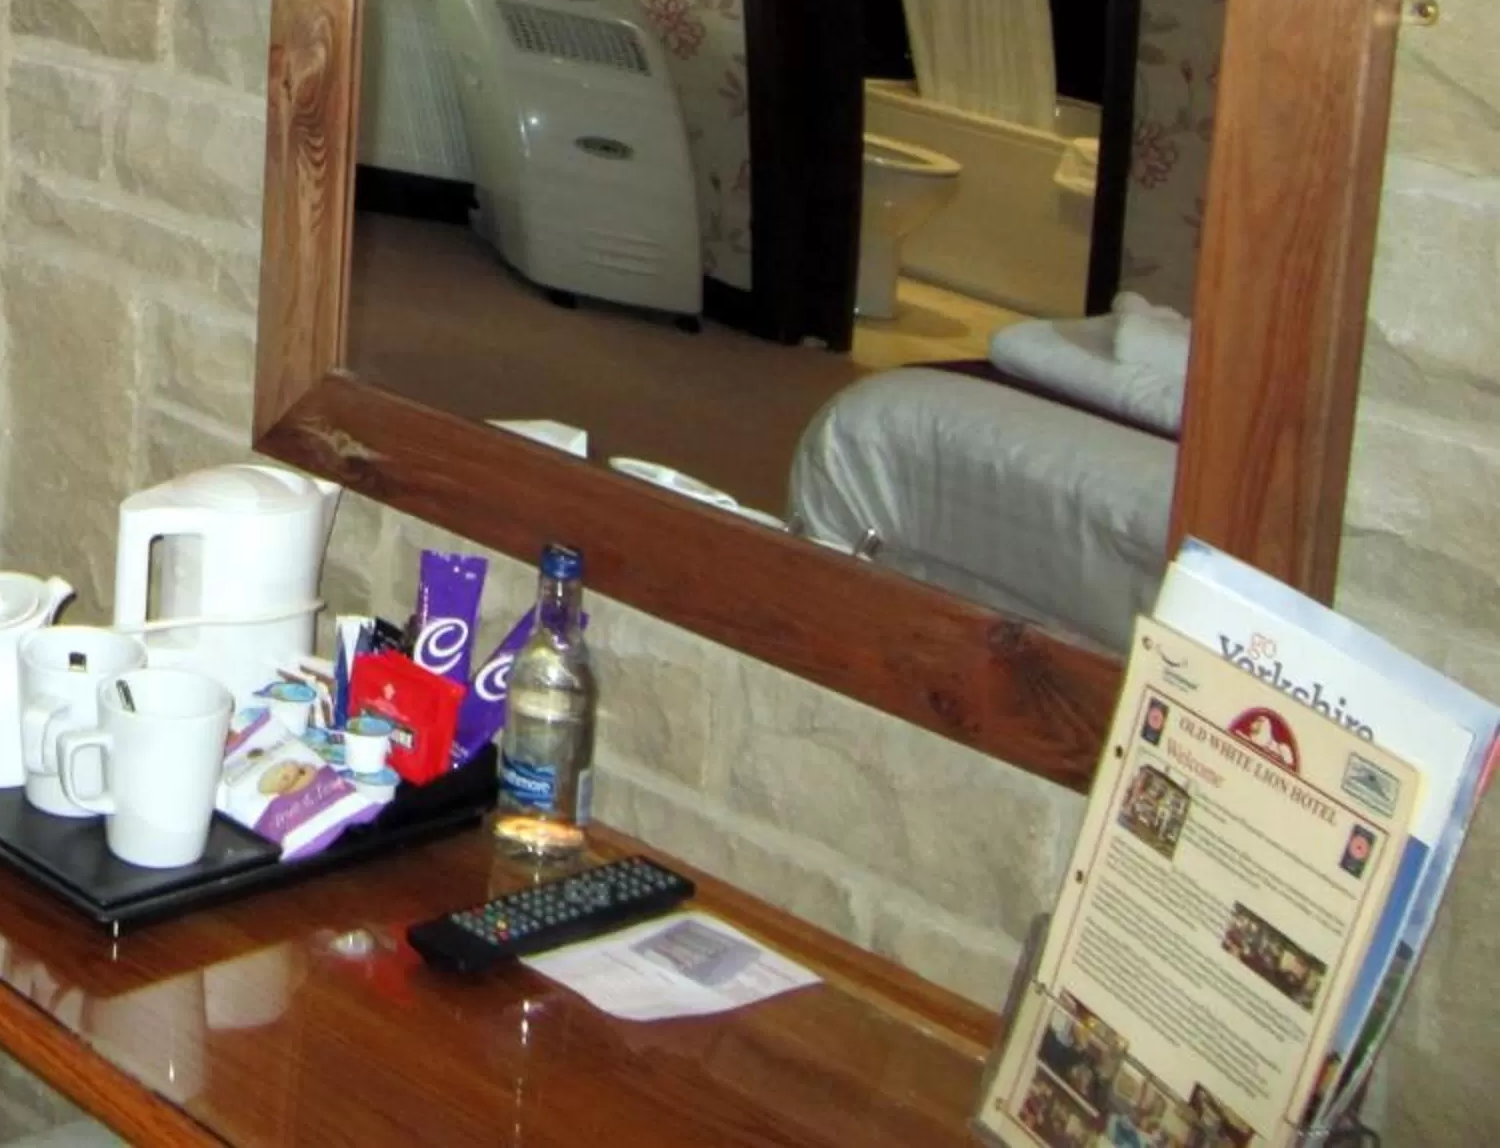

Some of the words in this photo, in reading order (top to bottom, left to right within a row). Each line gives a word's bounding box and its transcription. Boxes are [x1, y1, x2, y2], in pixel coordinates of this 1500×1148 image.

[1179, 716, 1207, 744] OLD
[1209, 732, 1251, 772] WHITE
[1253, 763, 1289, 797] LION
[1290, 785, 1338, 827] HOTEL
